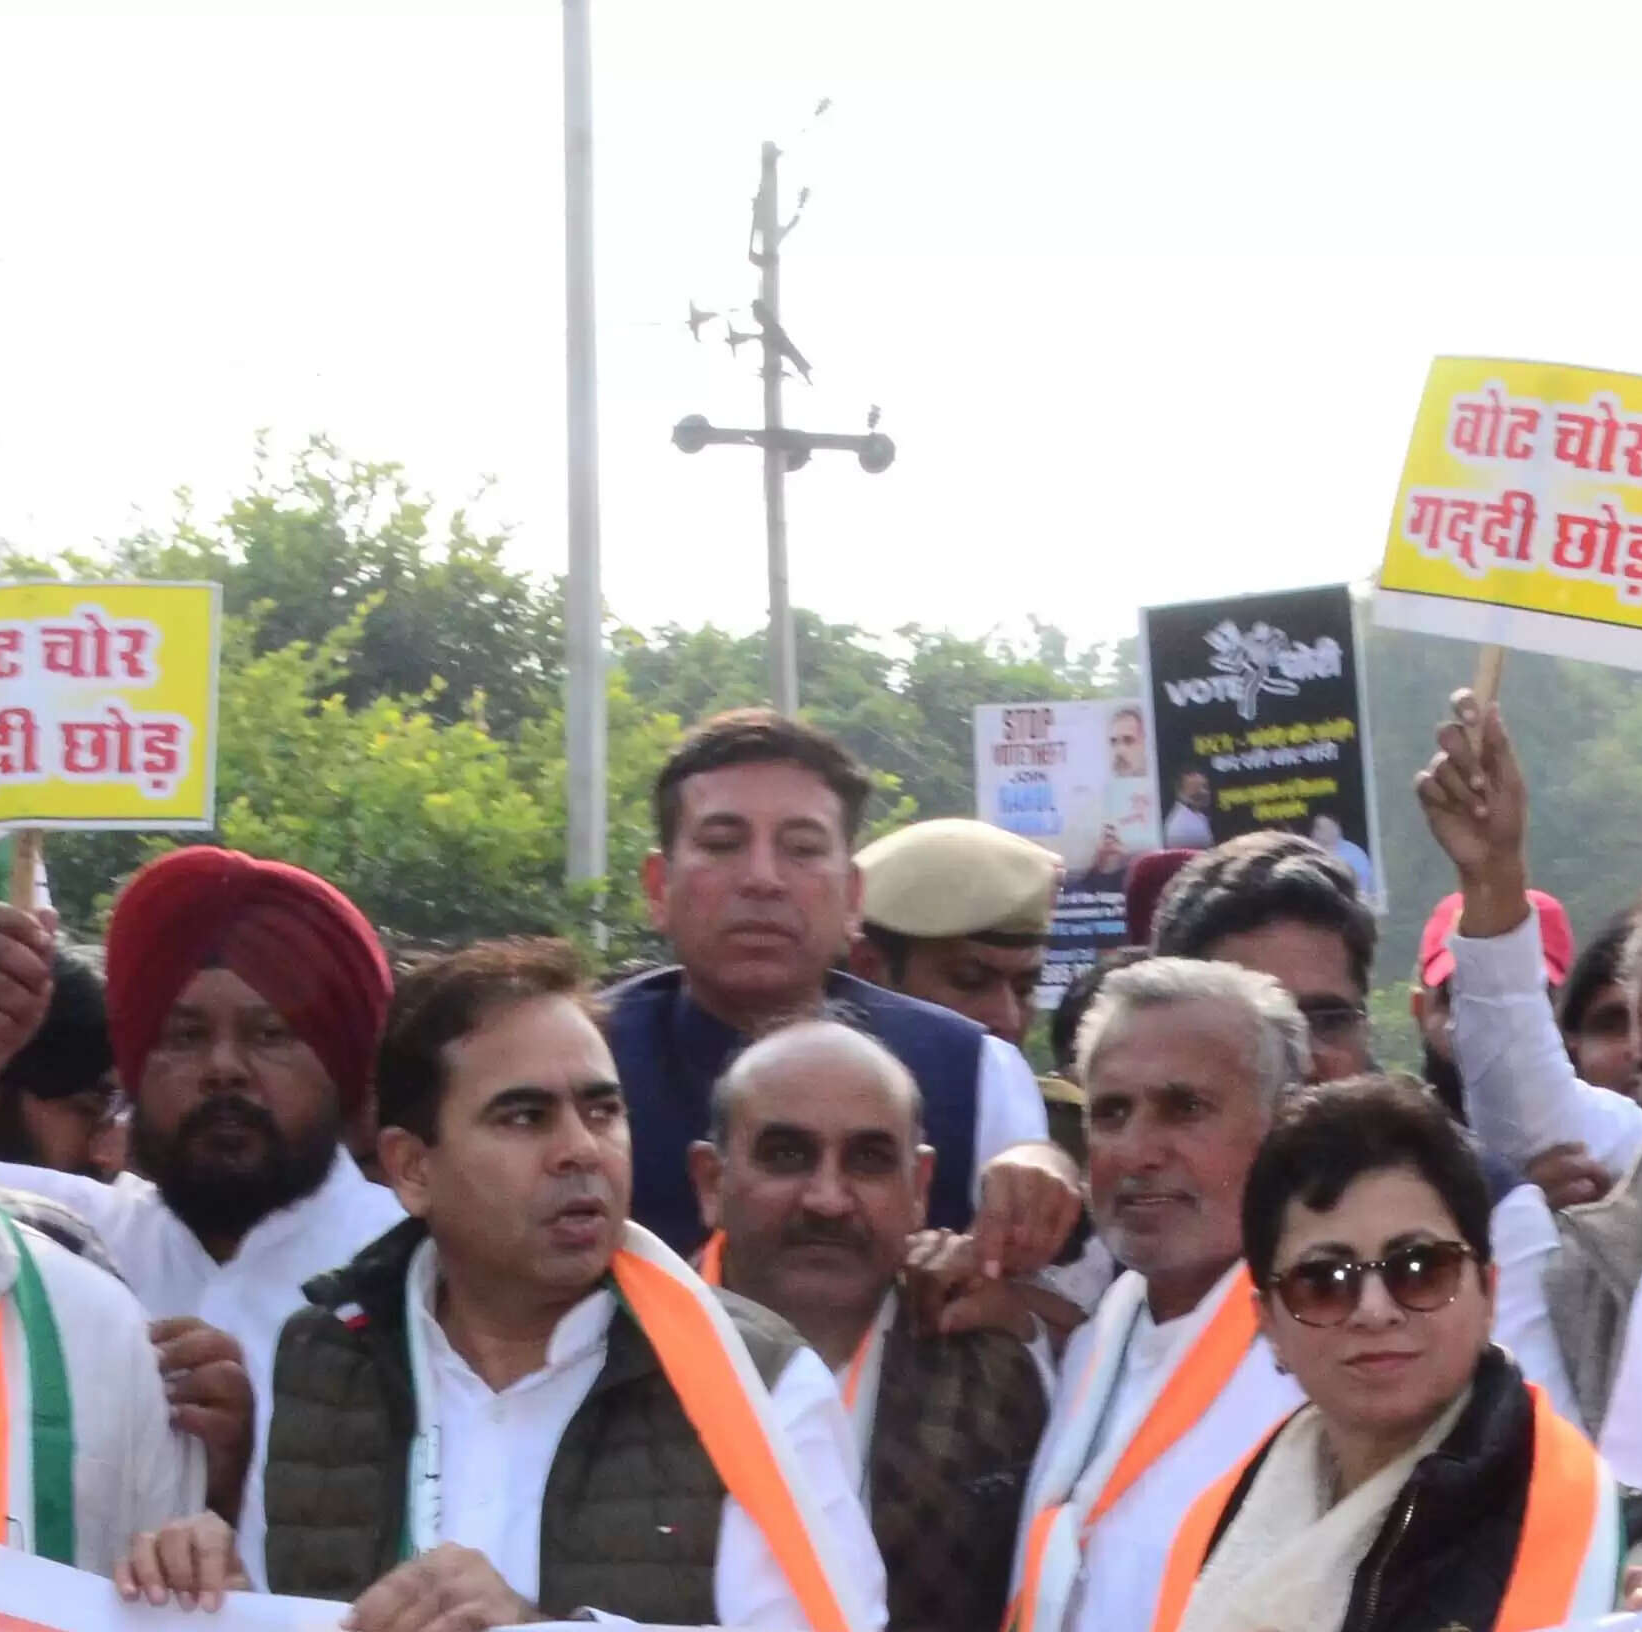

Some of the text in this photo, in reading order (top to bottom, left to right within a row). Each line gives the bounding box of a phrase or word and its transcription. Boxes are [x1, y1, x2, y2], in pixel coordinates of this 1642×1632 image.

[1453, 388, 1541, 460] वोट
[1408, 489, 1538, 568] गद्दी
[41, 613, 150, 678] चोर
[59, 707, 182, 789] छोड़
